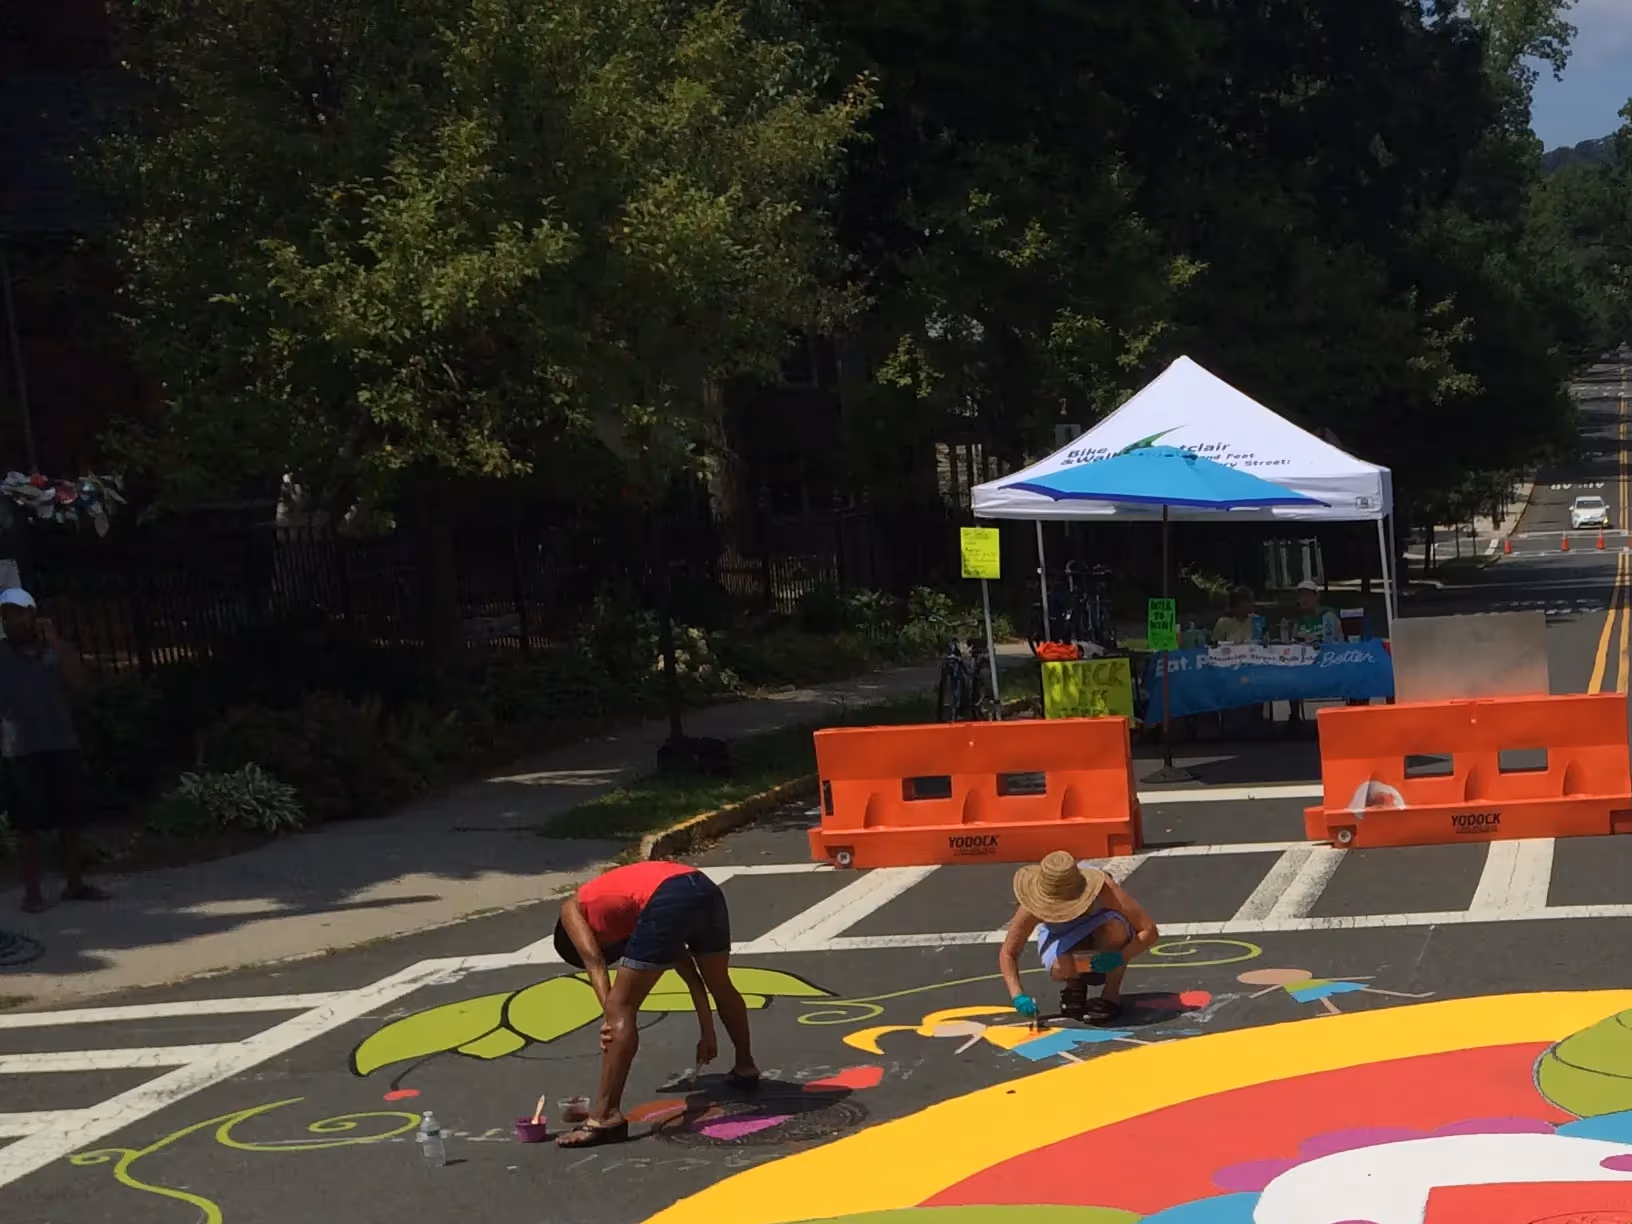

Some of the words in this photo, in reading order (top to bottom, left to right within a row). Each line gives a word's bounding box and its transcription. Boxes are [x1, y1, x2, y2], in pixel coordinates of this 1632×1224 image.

[1067, 448, 1108, 459] Bike
[1179, 441, 1231, 453] tclair
[1320, 650, 1377, 668] Better
[1451, 813, 1501, 826] YODOCK
[948, 834, 999, 848] YODOCK
